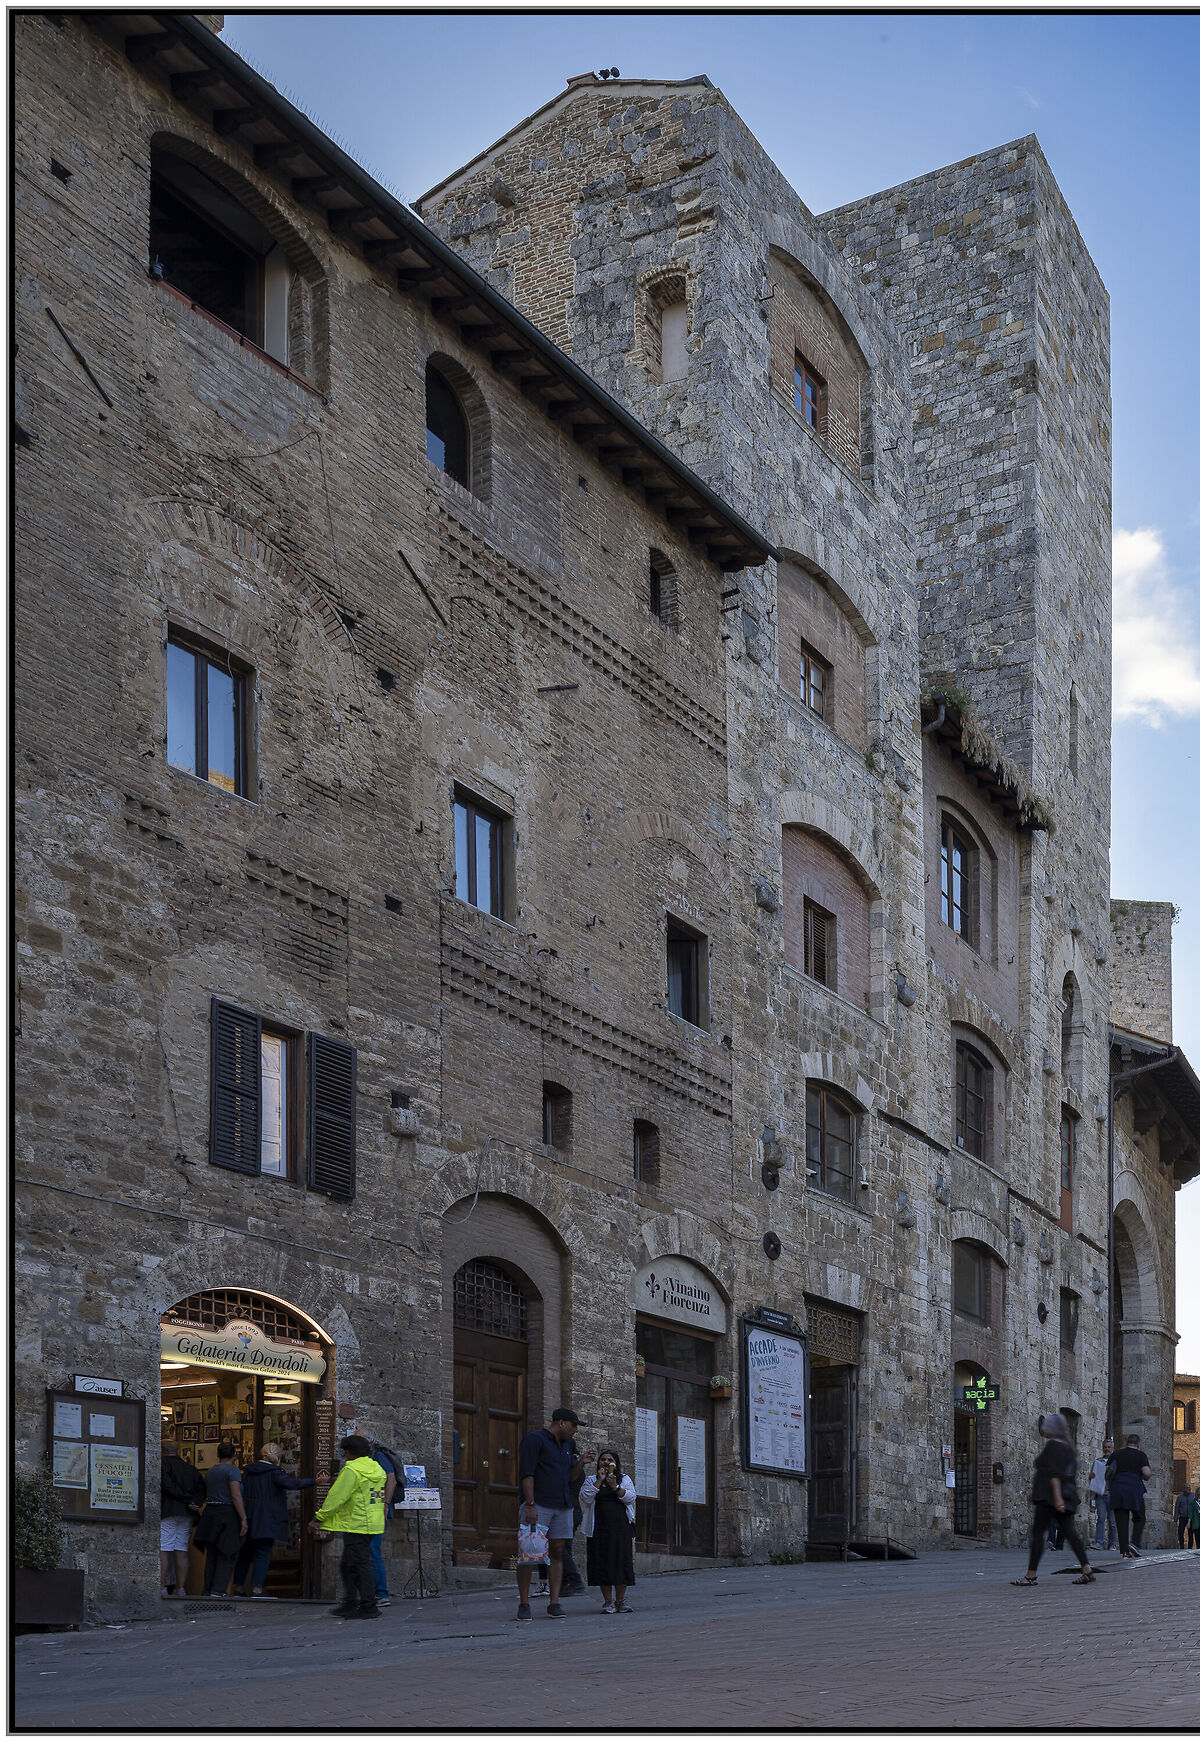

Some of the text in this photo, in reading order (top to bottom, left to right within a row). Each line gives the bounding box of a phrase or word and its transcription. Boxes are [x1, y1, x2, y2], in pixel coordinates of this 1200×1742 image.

[664, 1277, 710, 1302] Vinaino
[663, 1289, 710, 1315] Fiorenza
[171, 1318, 205, 1329] POGGIBONSI
[245, 1325, 259, 1337] 1992
[749, 1339, 777, 1355] ACCADE
[177, 1338, 309, 1373] Gelateria Dondoli
[205, 1358, 224, 1366] world's
[259, 1366, 277, 1374] Gelato
[94, 1386, 118, 1395] auser
[95, 1463, 127, 1471] CESSATE
